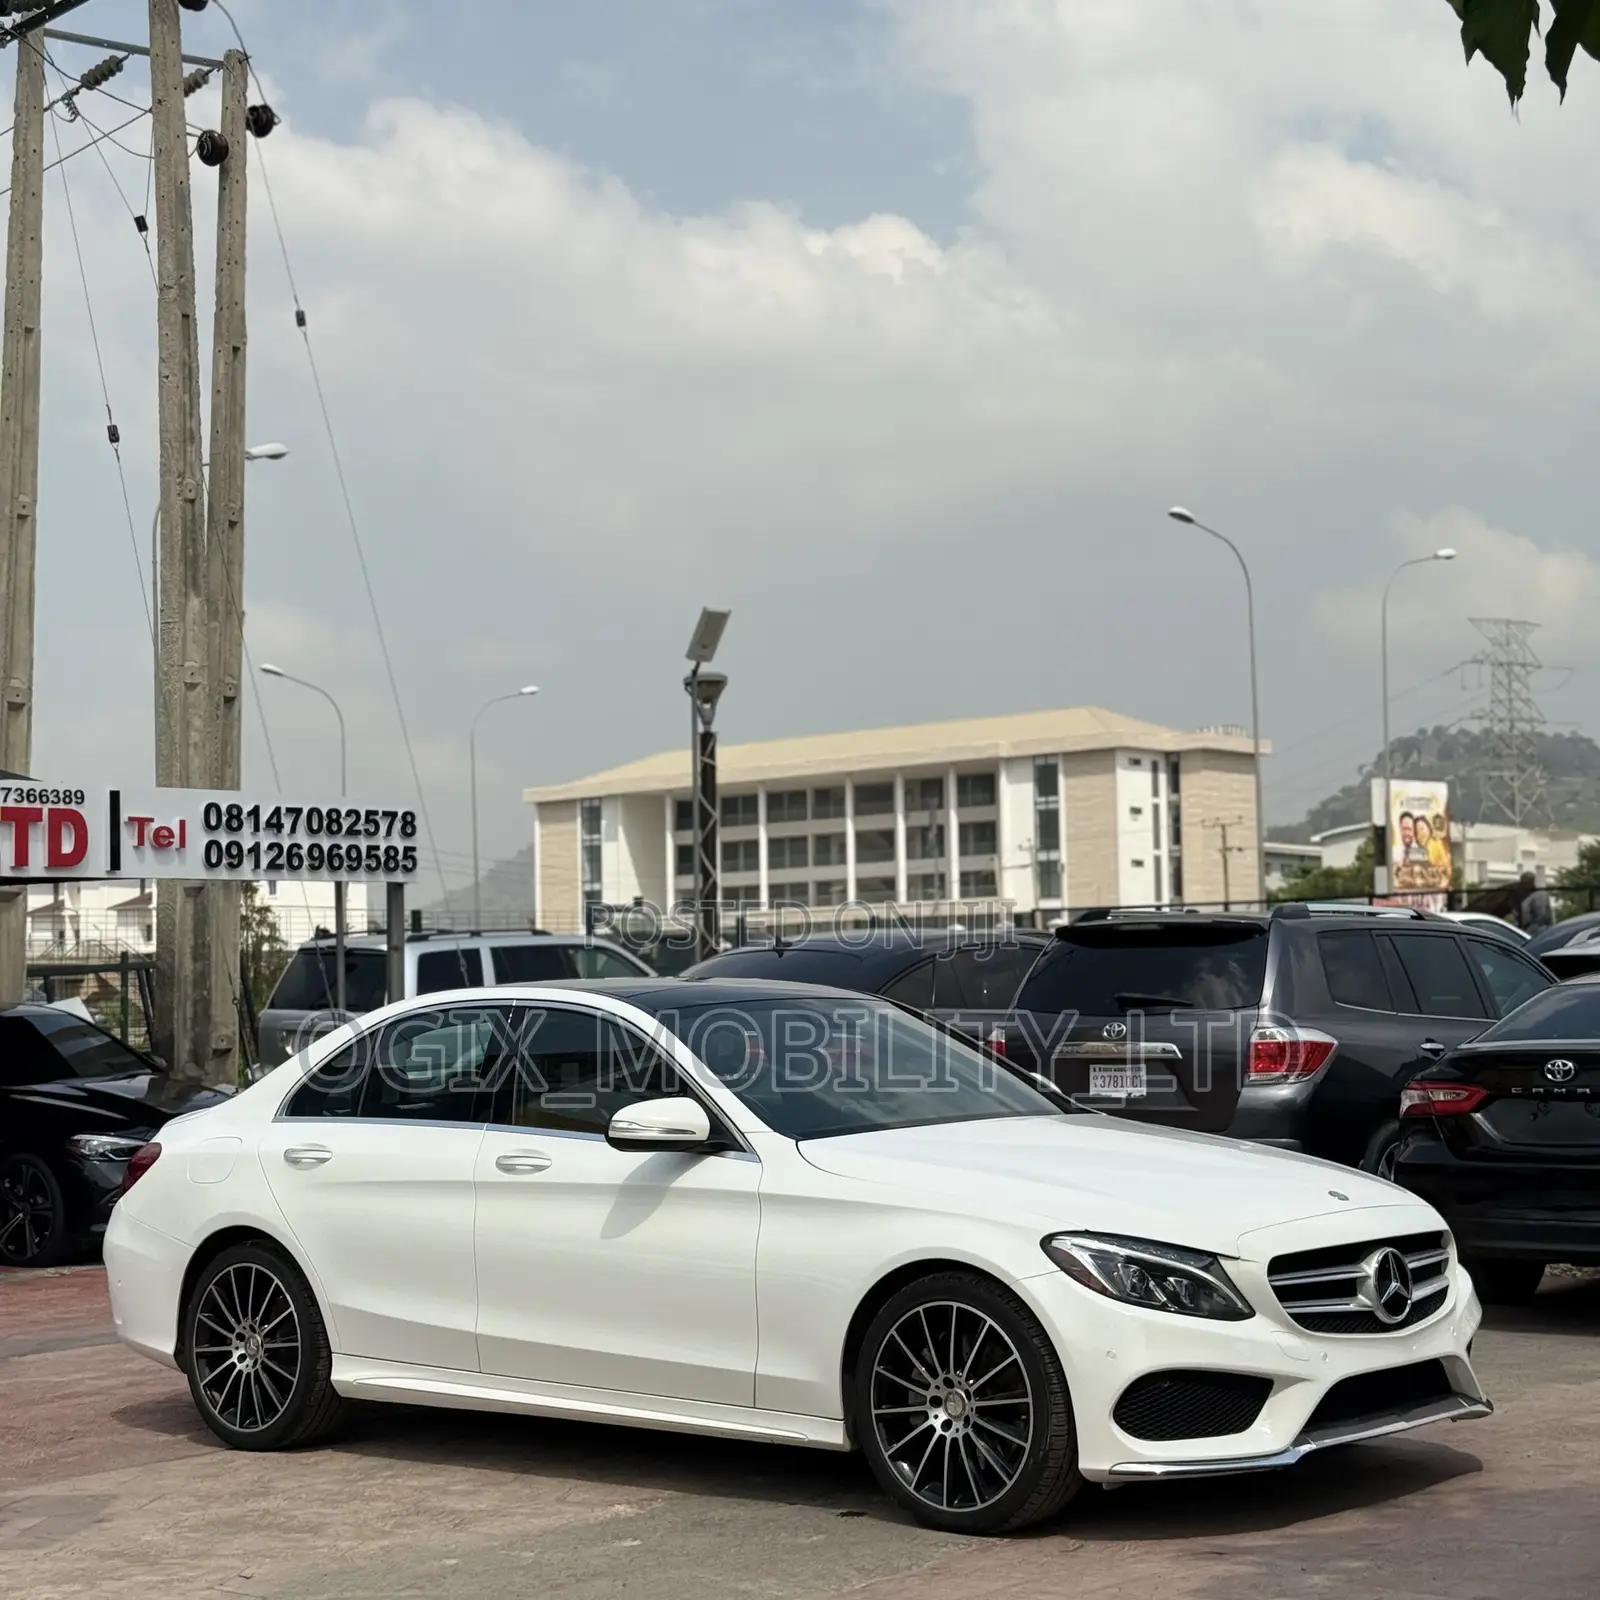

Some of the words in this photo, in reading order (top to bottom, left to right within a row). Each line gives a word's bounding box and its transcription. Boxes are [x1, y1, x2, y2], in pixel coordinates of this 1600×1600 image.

[0, 787, 85, 805] 7366389
[0, 806, 88, 867] TD
[127, 816, 186, 849] Tel
[203, 802, 417, 837] 08147082578
[204, 839, 417, 873] 09126969585
